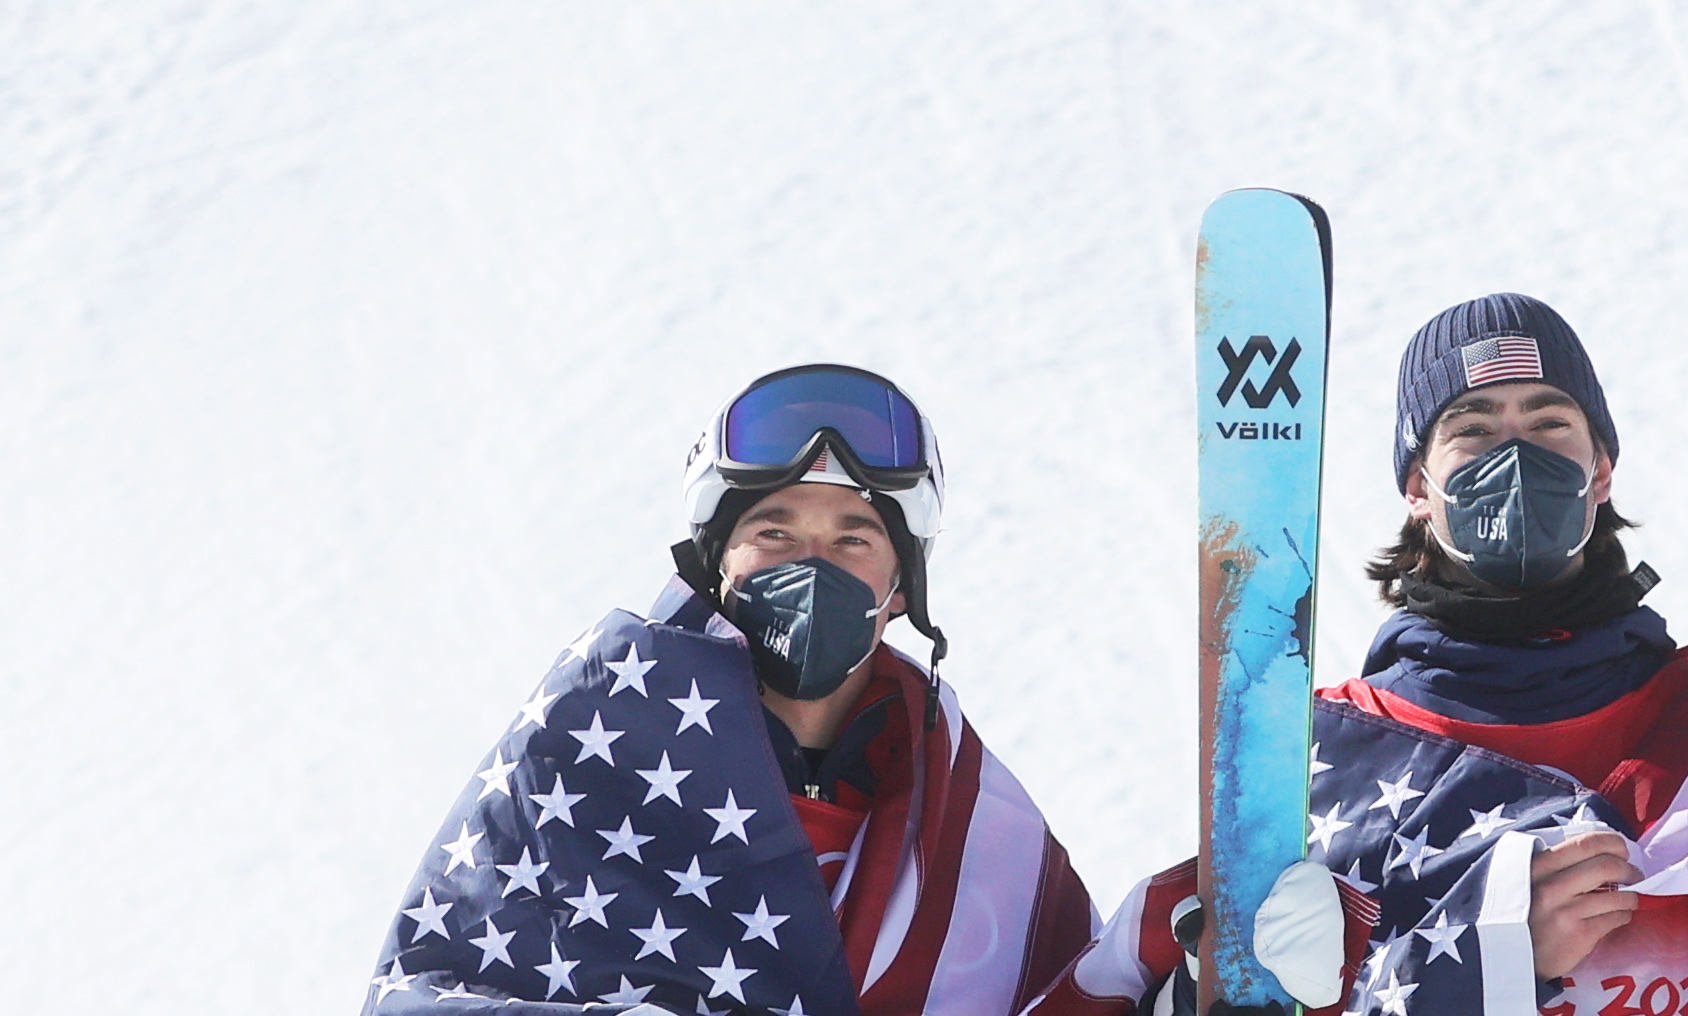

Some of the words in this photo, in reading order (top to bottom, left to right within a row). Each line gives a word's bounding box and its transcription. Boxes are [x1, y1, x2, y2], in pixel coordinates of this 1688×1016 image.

[1215, 421, 1301, 440] Völkl
[684, 431, 706, 477] OC
[1477, 516, 1508, 541] USA
[763, 625, 790, 661] USA
